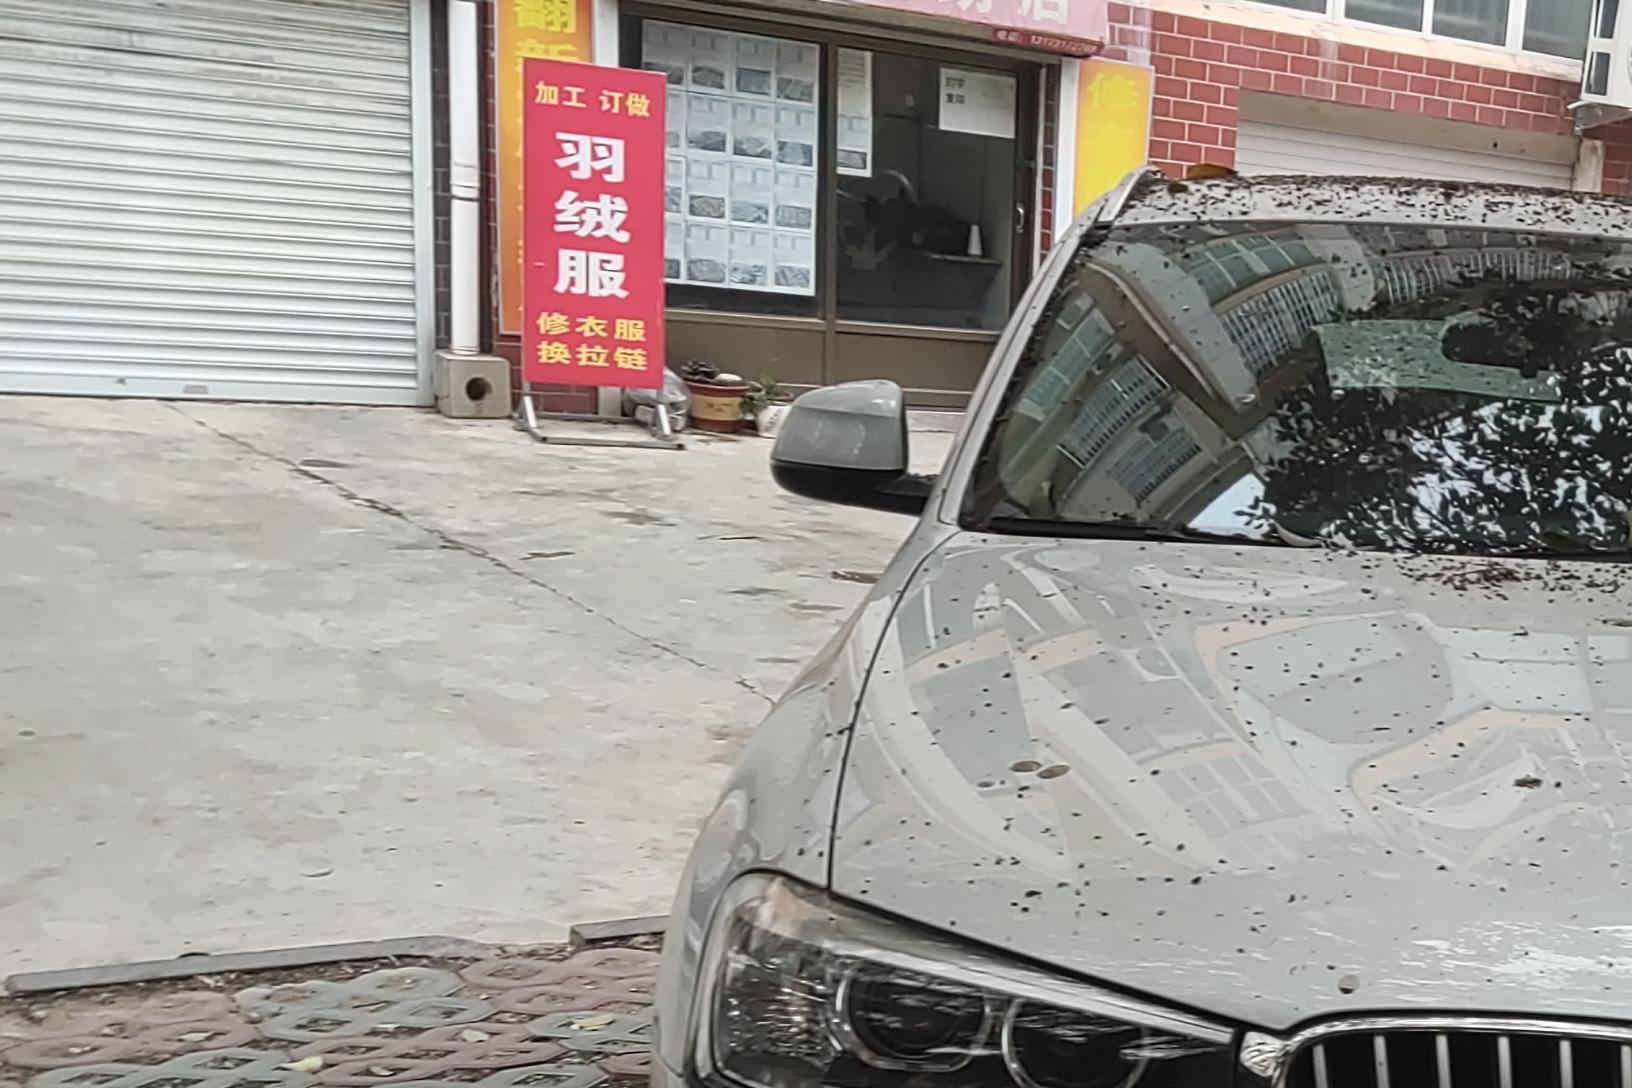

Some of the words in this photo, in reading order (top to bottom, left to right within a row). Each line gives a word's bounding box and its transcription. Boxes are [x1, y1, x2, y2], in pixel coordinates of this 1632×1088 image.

[534, 80, 586, 108] 加工
[599, 88, 651, 117] 订做
[552, 131, 632, 300] 羽绒服
[536, 312, 646, 342] 修衣服
[537, 342, 648, 370] 换拉链
